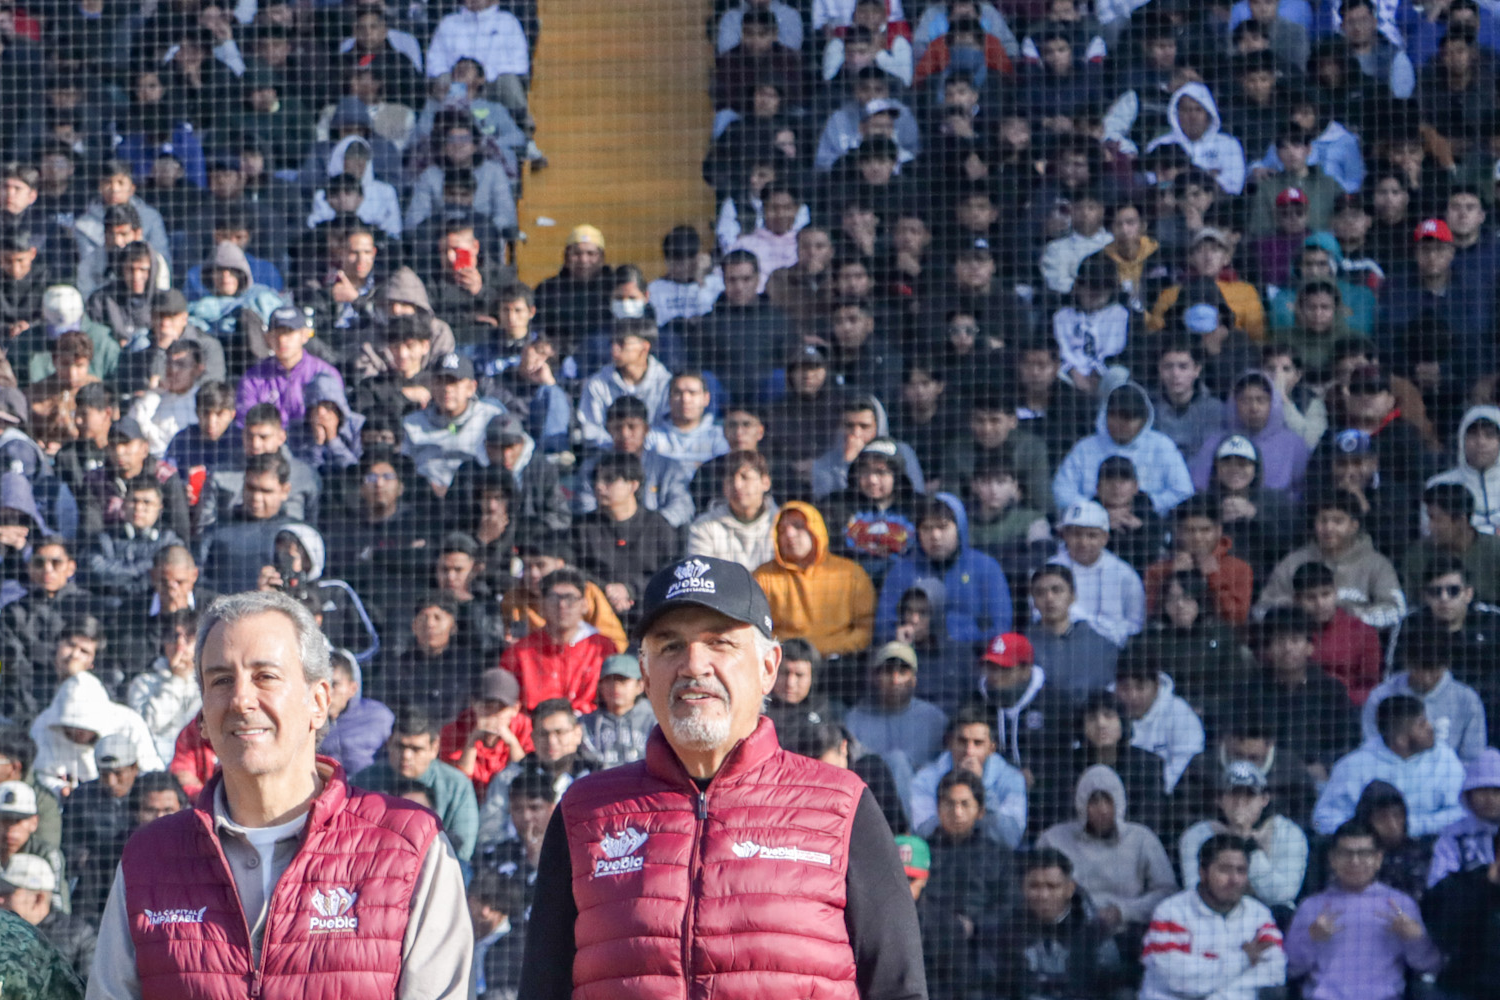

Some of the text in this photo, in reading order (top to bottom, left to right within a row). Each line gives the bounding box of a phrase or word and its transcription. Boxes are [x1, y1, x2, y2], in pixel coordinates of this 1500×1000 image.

[668, 577, 716, 594] Puebla
[595, 855, 644, 873] Puebla
[150, 913, 203, 925] IMPARABLE
[310, 915, 358, 930] Puebla
